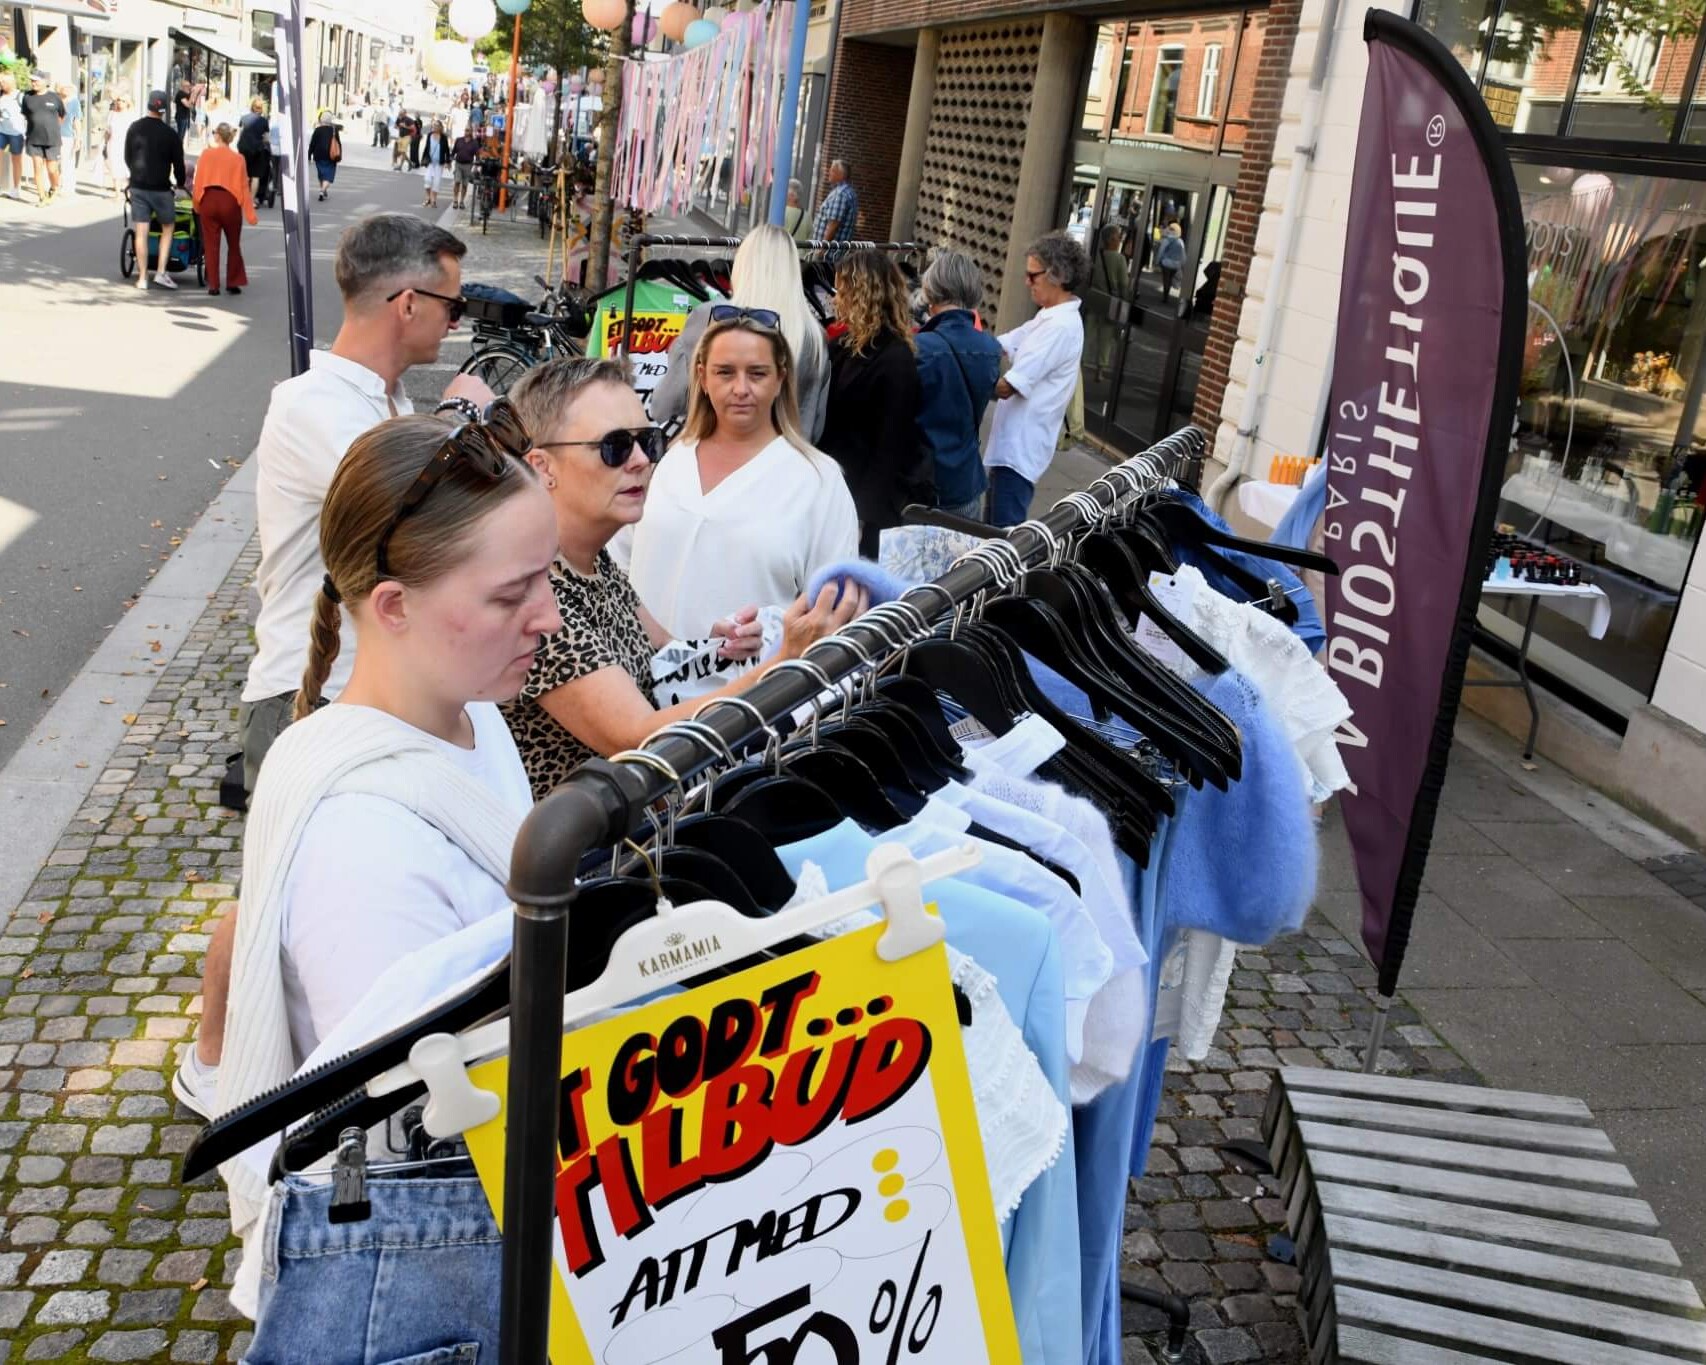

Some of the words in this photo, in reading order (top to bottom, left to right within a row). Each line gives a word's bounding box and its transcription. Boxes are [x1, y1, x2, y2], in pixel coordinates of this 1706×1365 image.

[639, 363, 668, 376] MED
[638, 935, 722, 977] KARMAMIA
[554, 1018, 932, 1279] TILBUD
[725, 1188, 862, 1277] MED
